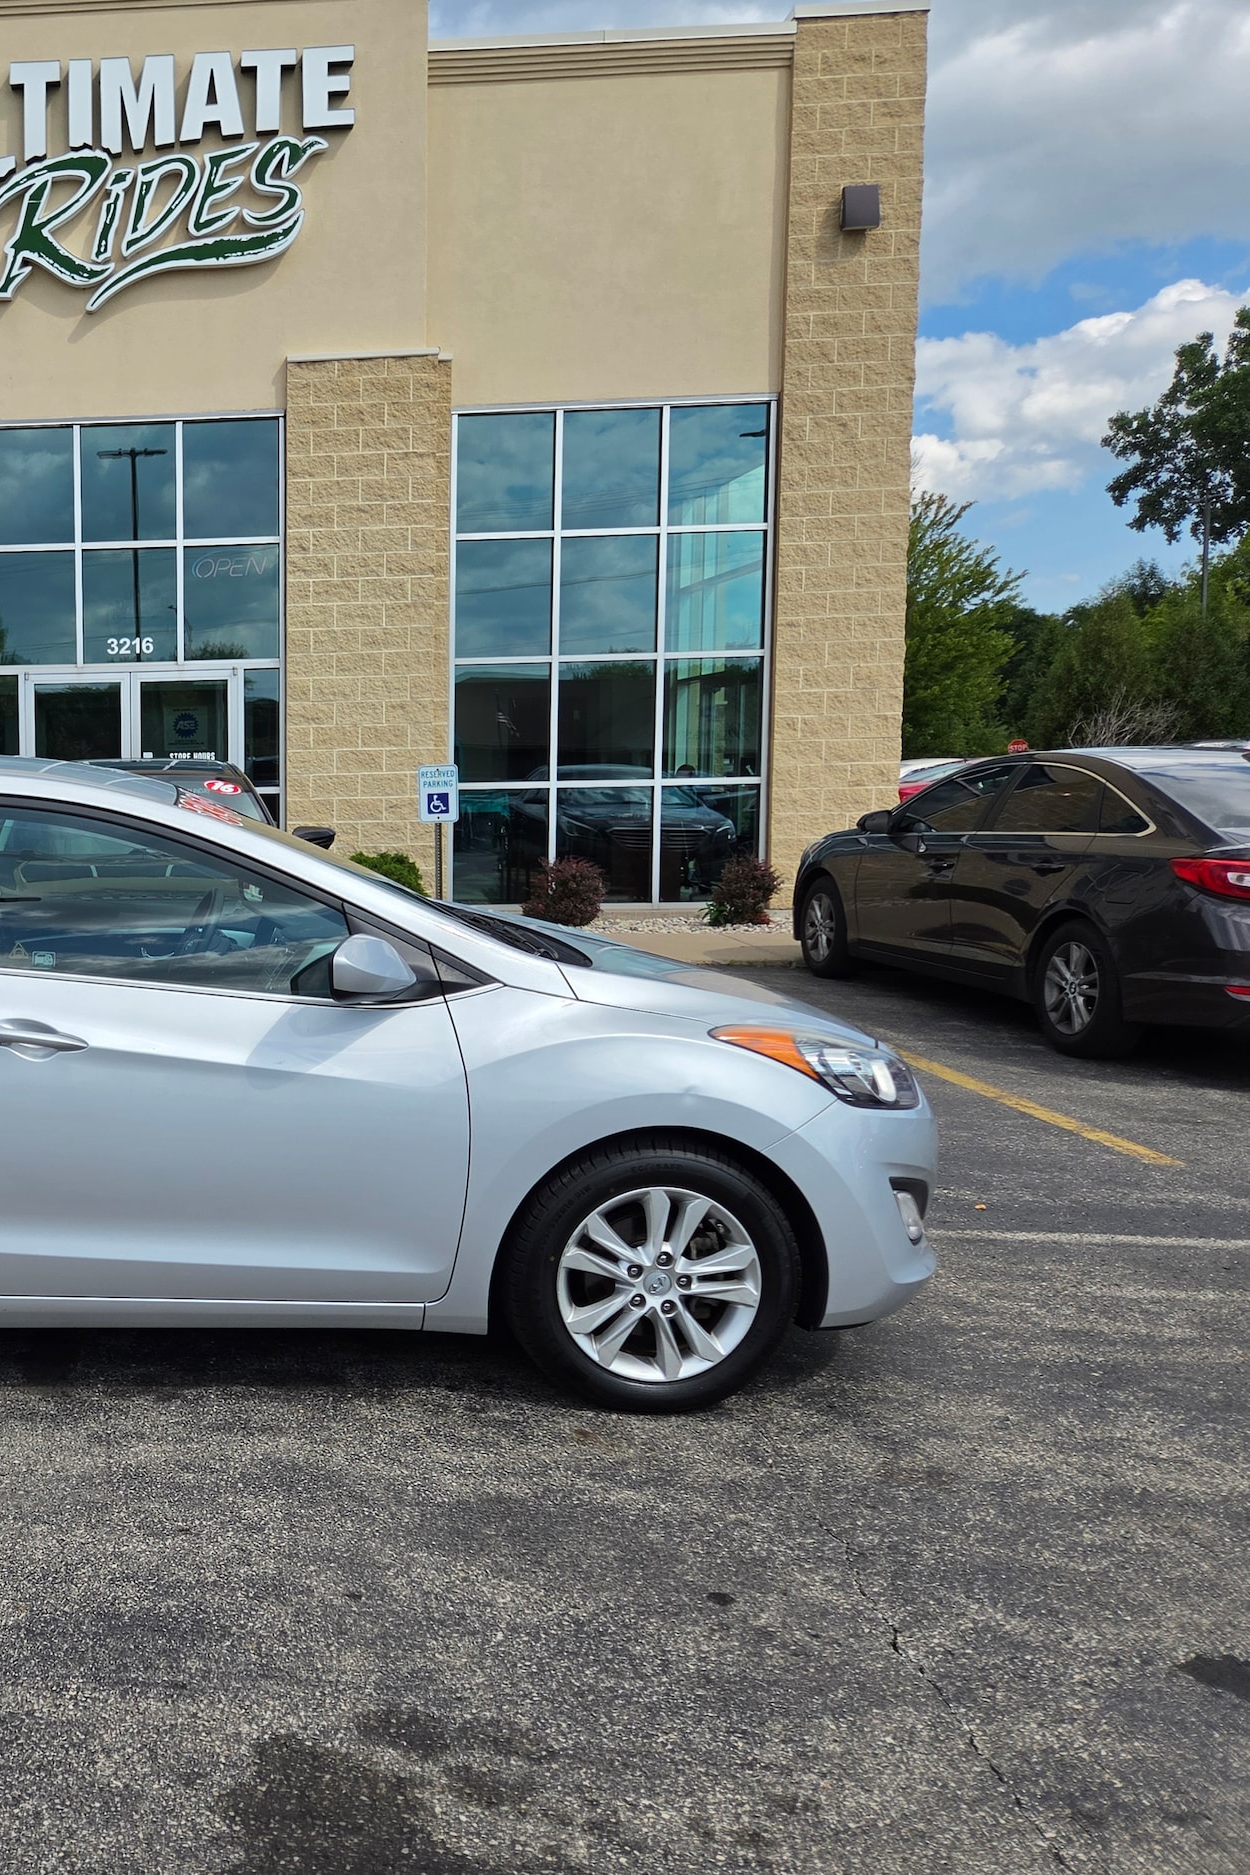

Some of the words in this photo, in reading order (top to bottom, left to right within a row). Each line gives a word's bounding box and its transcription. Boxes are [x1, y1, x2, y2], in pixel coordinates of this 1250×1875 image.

[195, 556, 267, 579] OPEN
[106, 636, 154, 655] 3216
[176, 720, 196, 730] ASE
[1009, 744, 1028, 753] STOP
[421, 770, 455, 779] RESERVED
[210, 780, 235, 793] 16
[423, 780, 453, 788] PARKING
